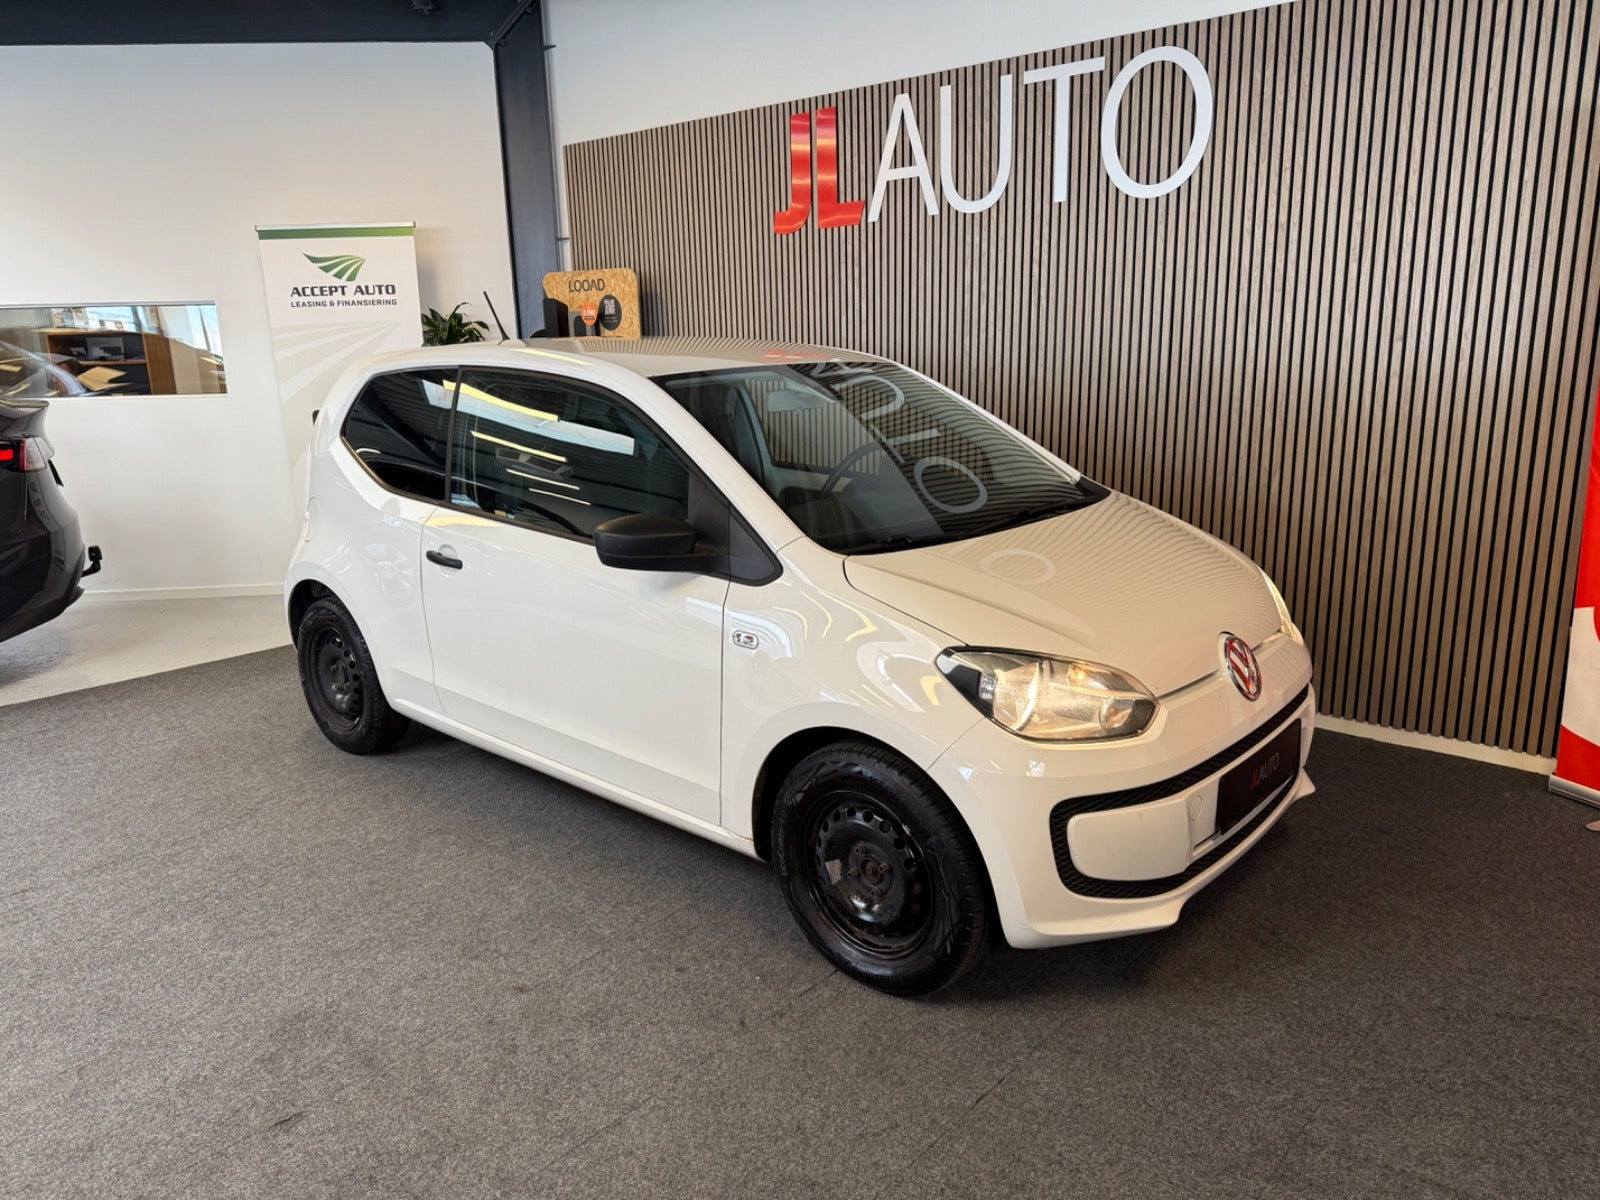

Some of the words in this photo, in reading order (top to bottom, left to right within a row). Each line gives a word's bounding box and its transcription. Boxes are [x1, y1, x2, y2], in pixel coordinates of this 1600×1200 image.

[290, 286, 347, 297] ACCEPT
[354, 284, 396, 296] AUTO
[291, 300, 327, 308] LEASING
